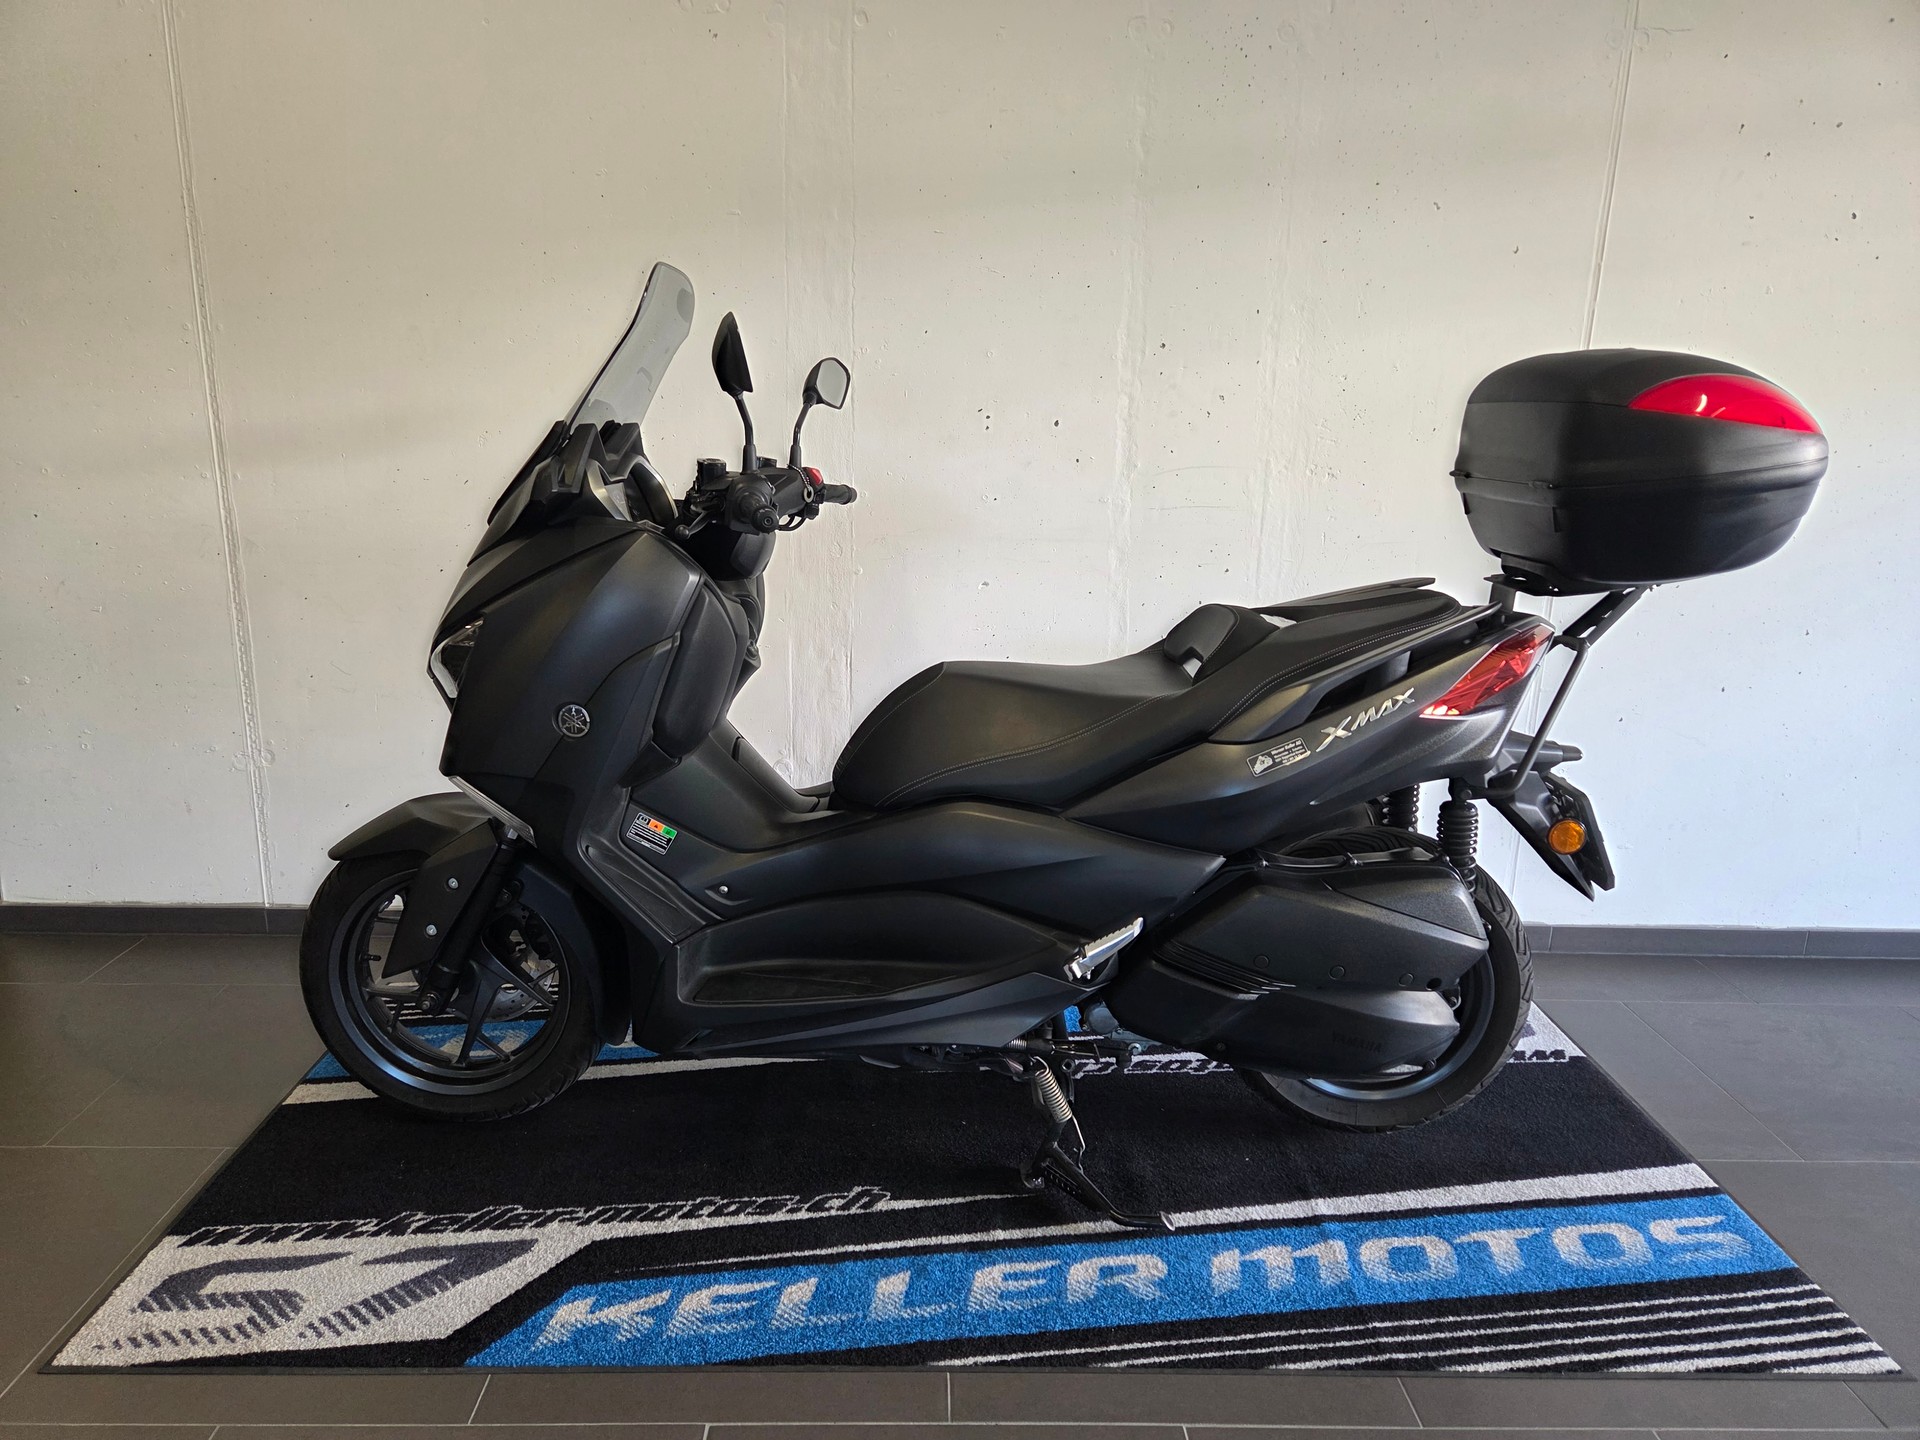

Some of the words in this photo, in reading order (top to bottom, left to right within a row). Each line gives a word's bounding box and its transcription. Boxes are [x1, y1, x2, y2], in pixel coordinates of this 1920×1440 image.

[1332, 1030, 1382, 1053] YAMAHA
[177, 1186, 891, 1248] www.keller-motos.ch
[531, 1254, 1168, 1351] KELLER
[1211, 1216, 1751, 1297] MOTOS
